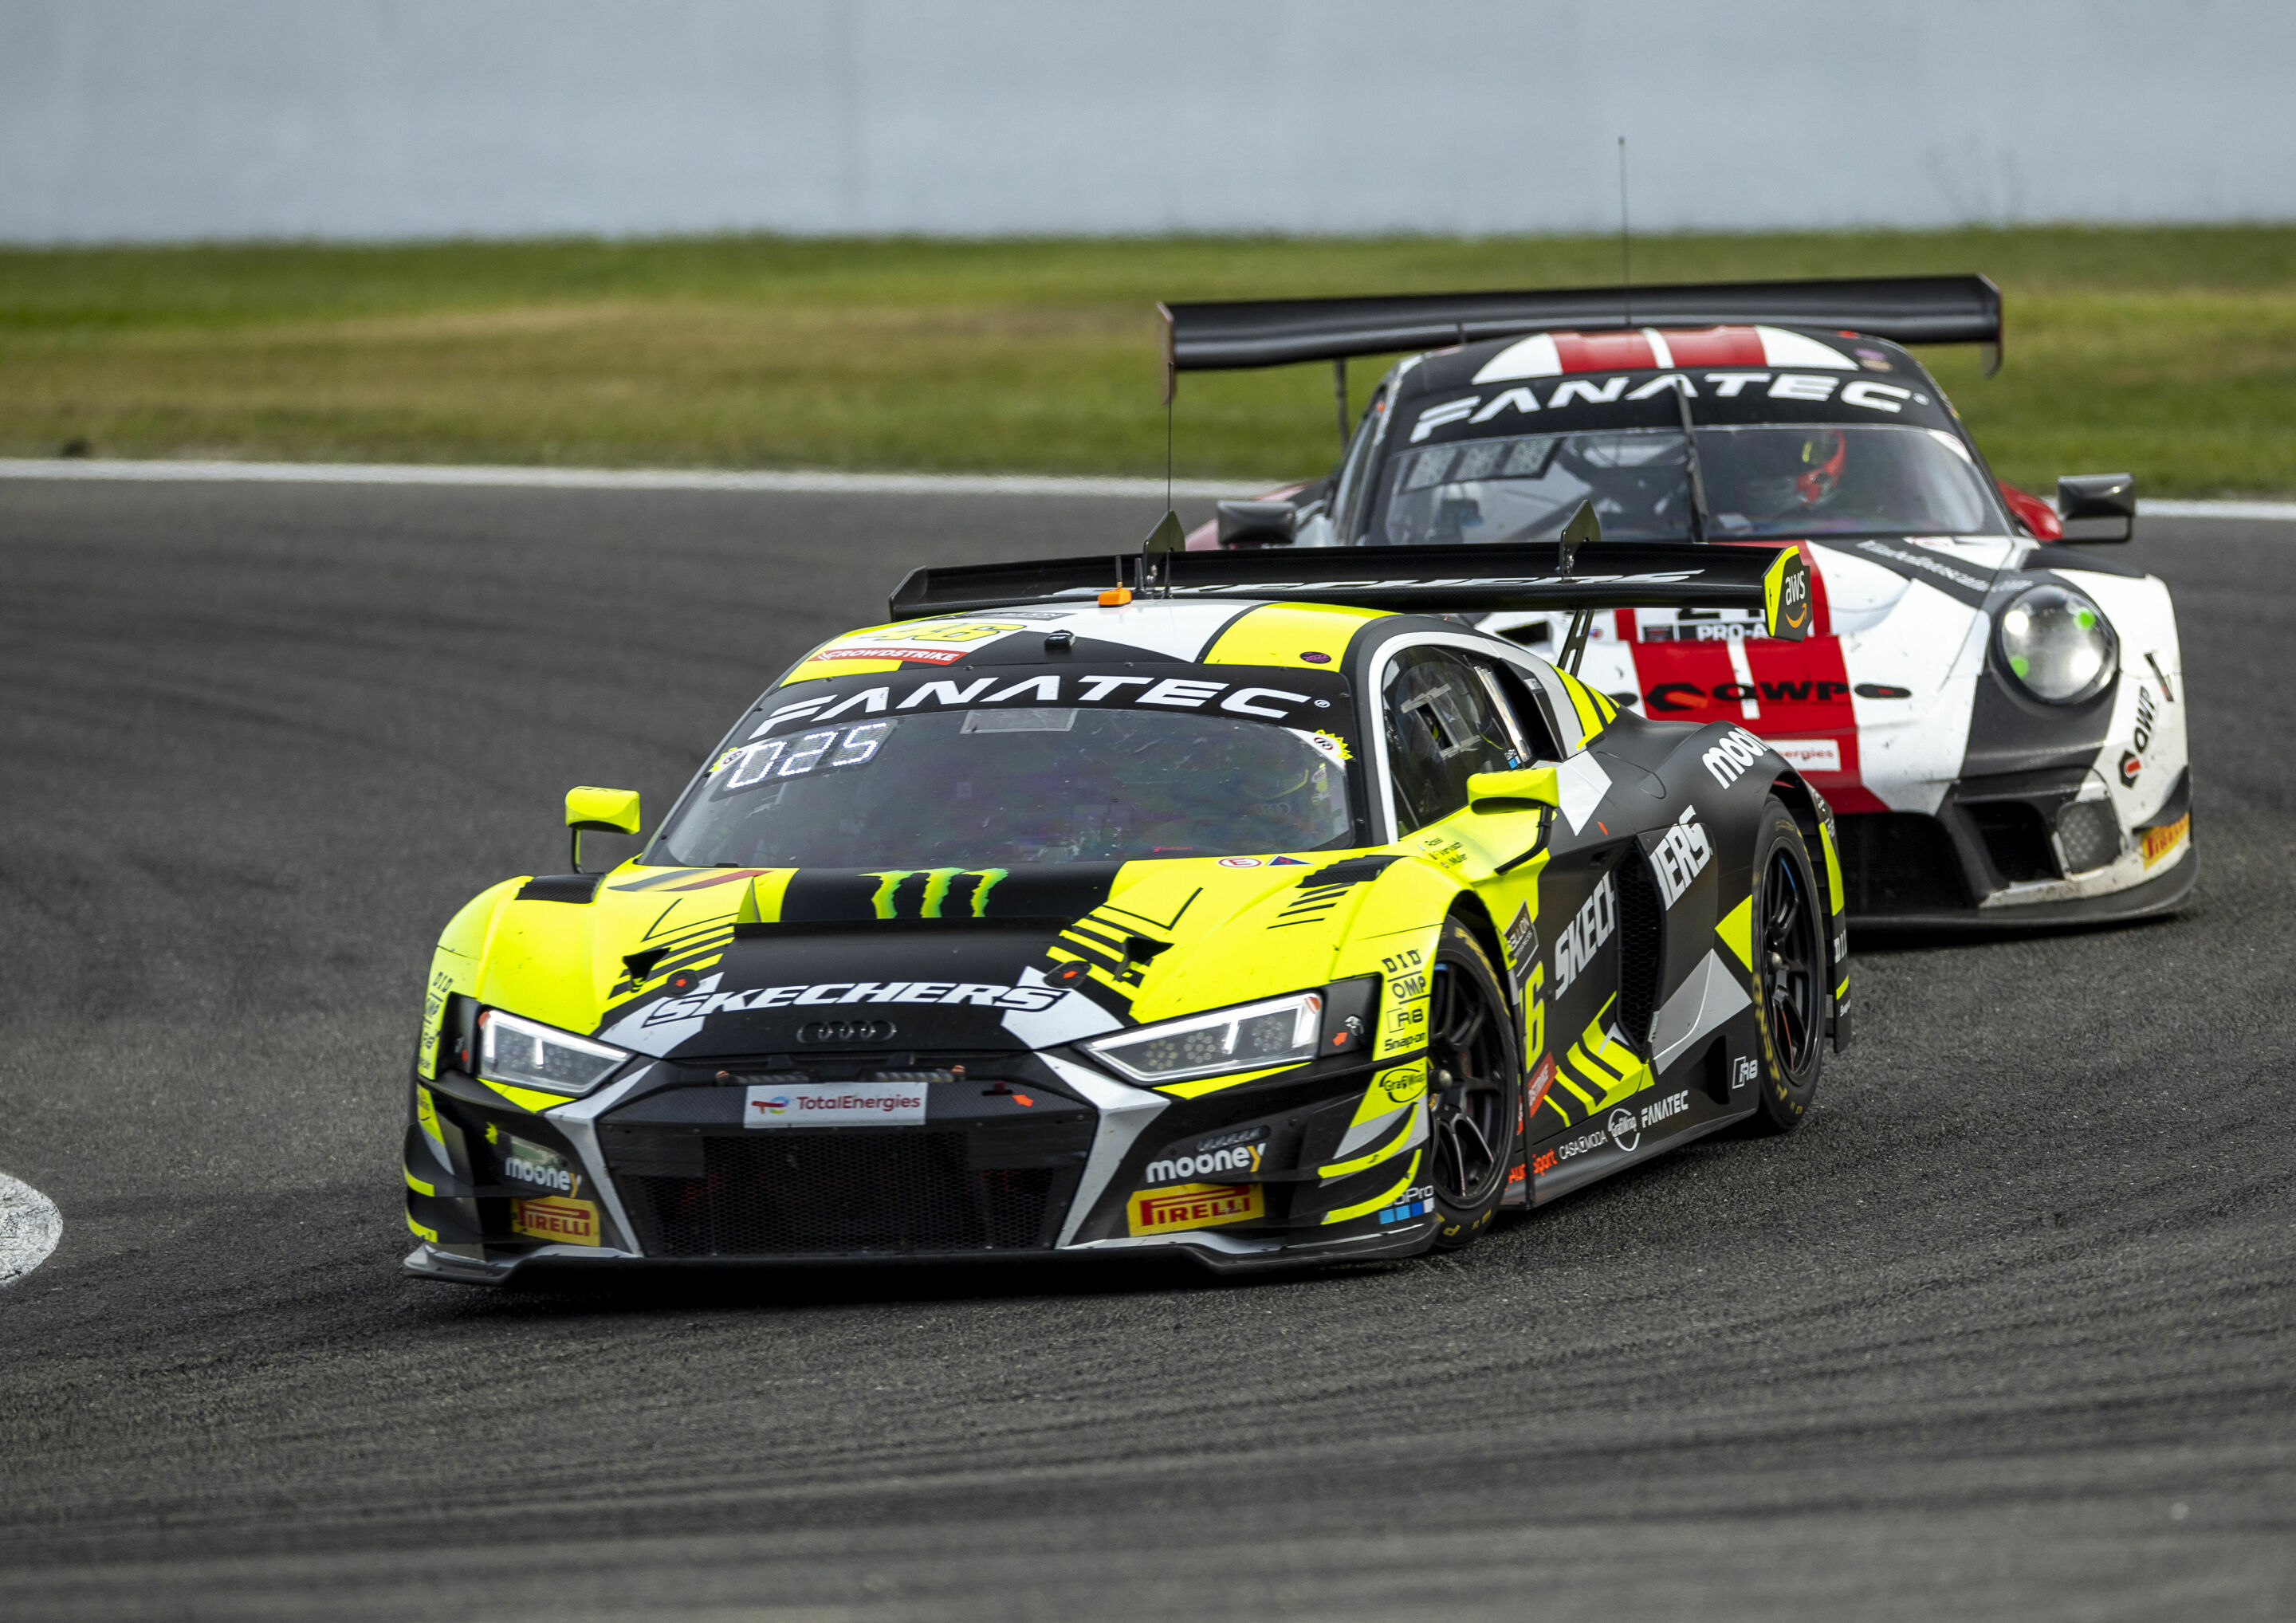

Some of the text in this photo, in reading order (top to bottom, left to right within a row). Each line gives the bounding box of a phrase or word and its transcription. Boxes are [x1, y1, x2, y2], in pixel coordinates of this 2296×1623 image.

[1411, 375, 1913, 444] FANATEC
[1785, 569, 1806, 606] aws
[859, 623, 1028, 643] 46
[1696, 623, 1769, 641] PRO-A
[826, 648, 961, 662] CROWDSTRIKE
[749, 675, 1312, 740] FANATEC
[1779, 749, 1834, 761] ergies
[1382, 949, 1421, 973] DID
[644, 981, 1071, 1028] SKECHERS
[1392, 975, 1426, 999] OMP
[1397, 1008, 1424, 1028] R8
[1518, 961, 1545, 1074] 6
[797, 1094, 921, 1114] TotalEnergies
[1641, 1090, 1689, 1129] FANATEC
[505, 1157, 582, 1199] mooney
[1146, 1142, 1266, 1184] mooney
[1140, 1185, 1251, 1227] PIRELLI
[1383, 1185, 1434, 1208] oPro
[519, 1200, 591, 1237] PIRELLI
